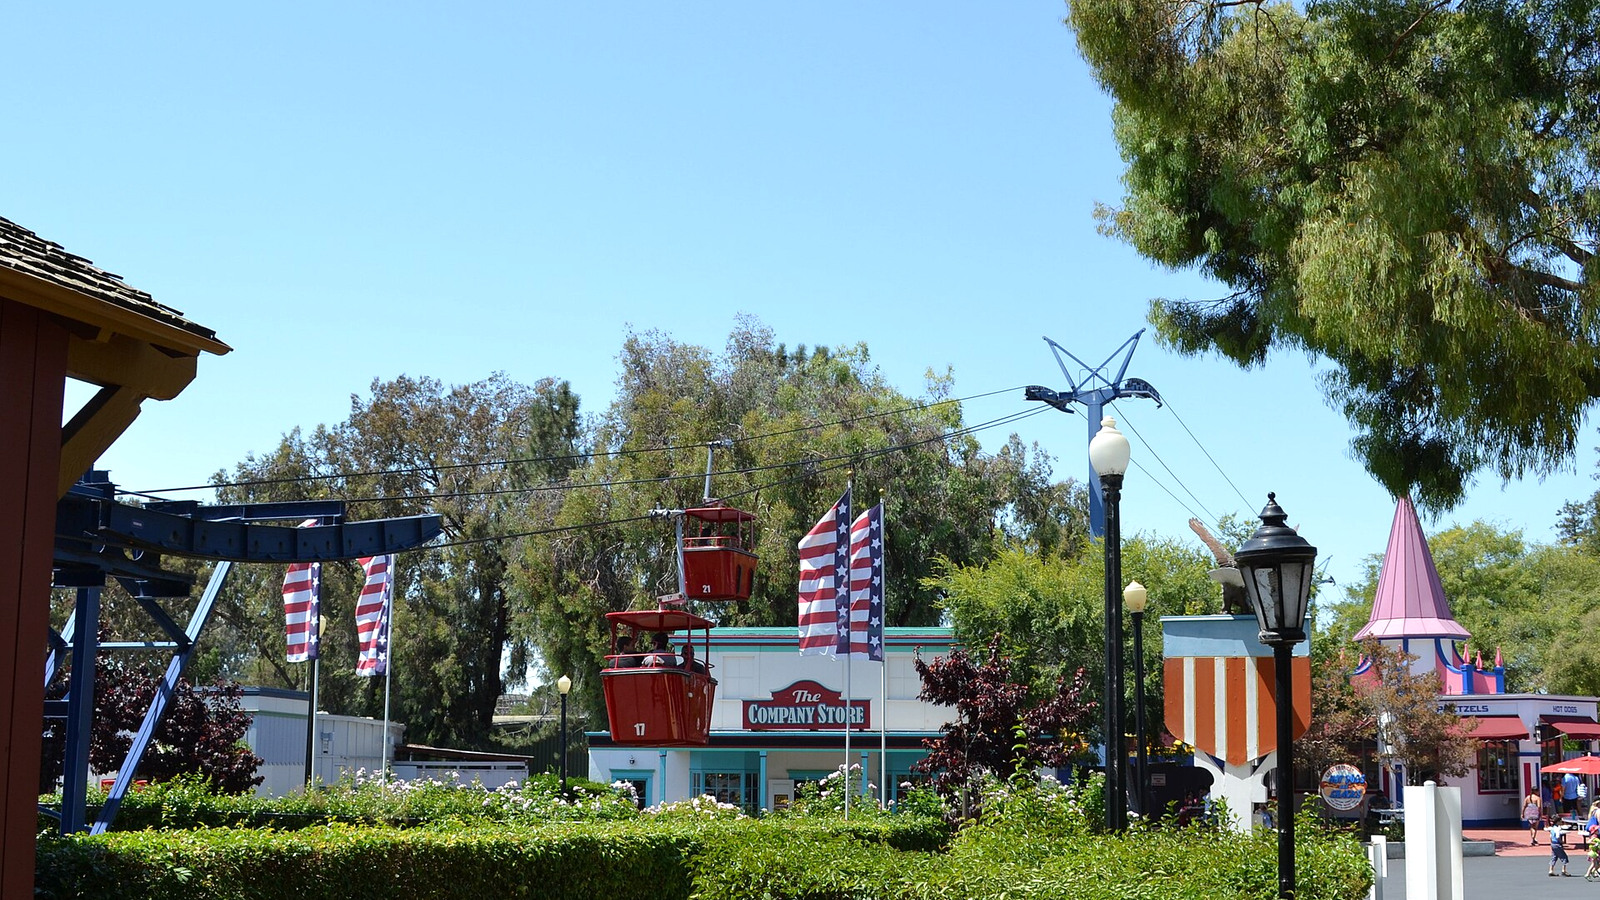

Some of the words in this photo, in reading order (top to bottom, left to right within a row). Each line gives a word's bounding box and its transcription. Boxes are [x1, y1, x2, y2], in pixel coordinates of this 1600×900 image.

[702, 584, 711, 593] 21
[792, 689, 821, 703] The
[748, 703, 815, 724] COMPANY
[817, 702, 865, 724] STORE
[1436, 705, 1489, 713] PTZELS
[1552, 705, 1563, 713] HOT
[1563, 705, 1578, 713] DOGS
[633, 722, 646, 736] 17
